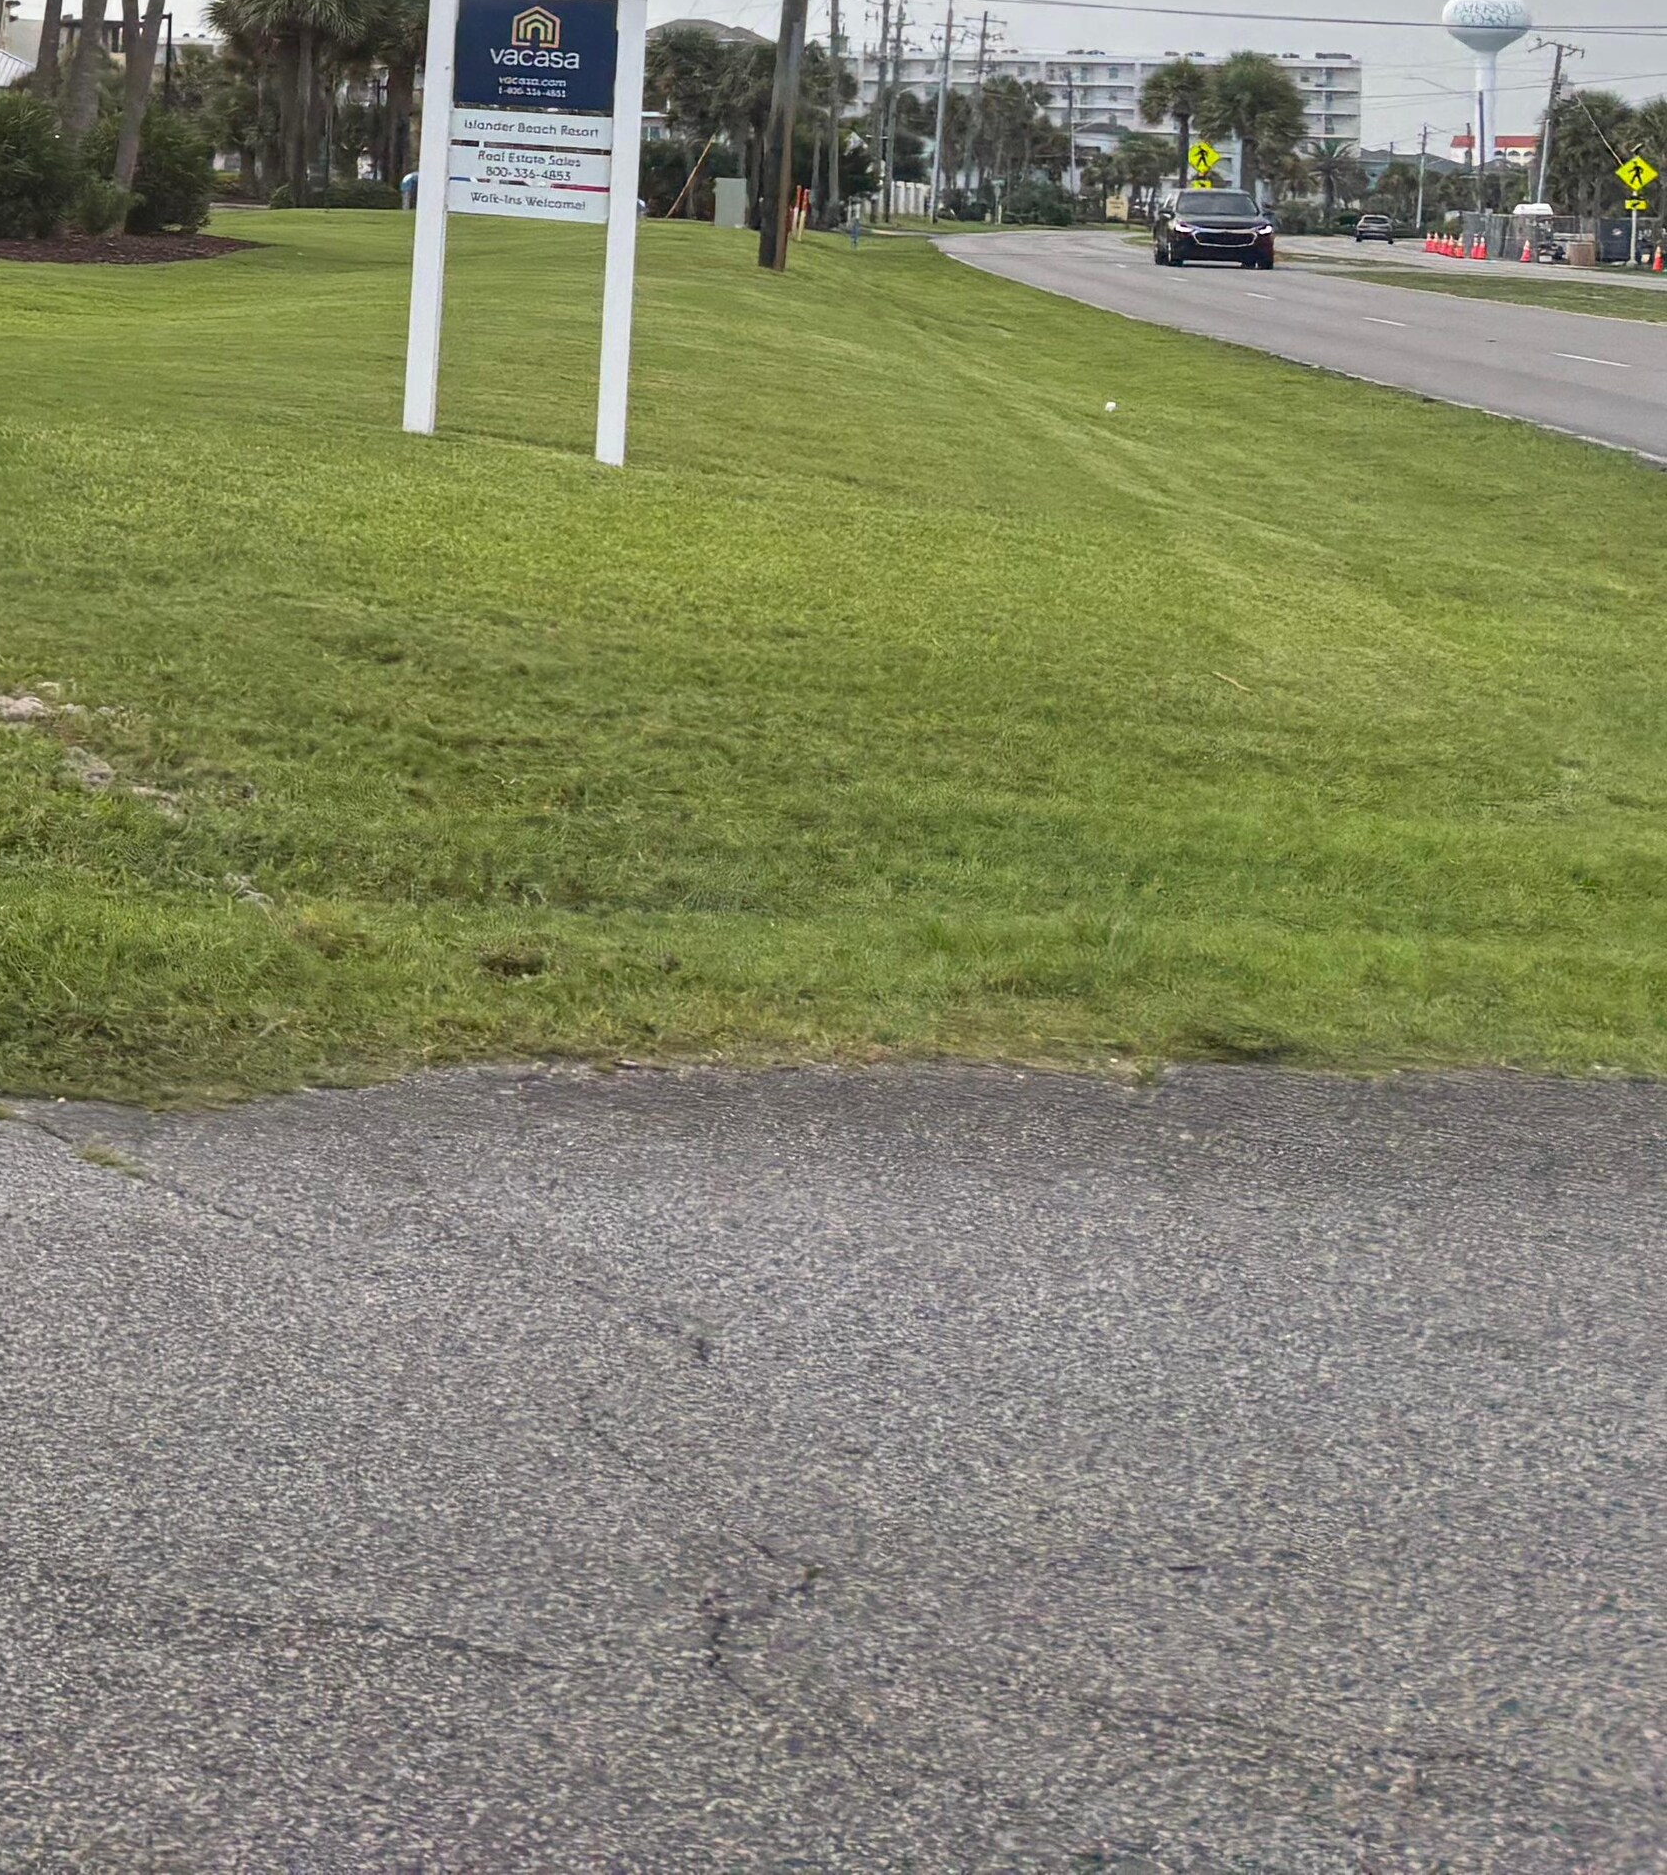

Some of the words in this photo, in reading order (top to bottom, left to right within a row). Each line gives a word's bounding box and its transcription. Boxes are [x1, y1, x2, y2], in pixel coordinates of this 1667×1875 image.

[490, 48, 580, 69] vacasa
[499, 77, 567, 87] vacasa.com
[465, 120, 514, 132] Islander
[517, 123, 556, 135] Beach
[561, 125, 599, 138] Resort
[478, 150, 505, 162] Real
[509, 153, 545, 165] Estate
[548, 155, 581, 167] Sales
[486, 166, 571, 181] 800-336-4853
[471, 192, 522, 205] Walk-Ins
[526, 196, 585, 210] Welcome!
